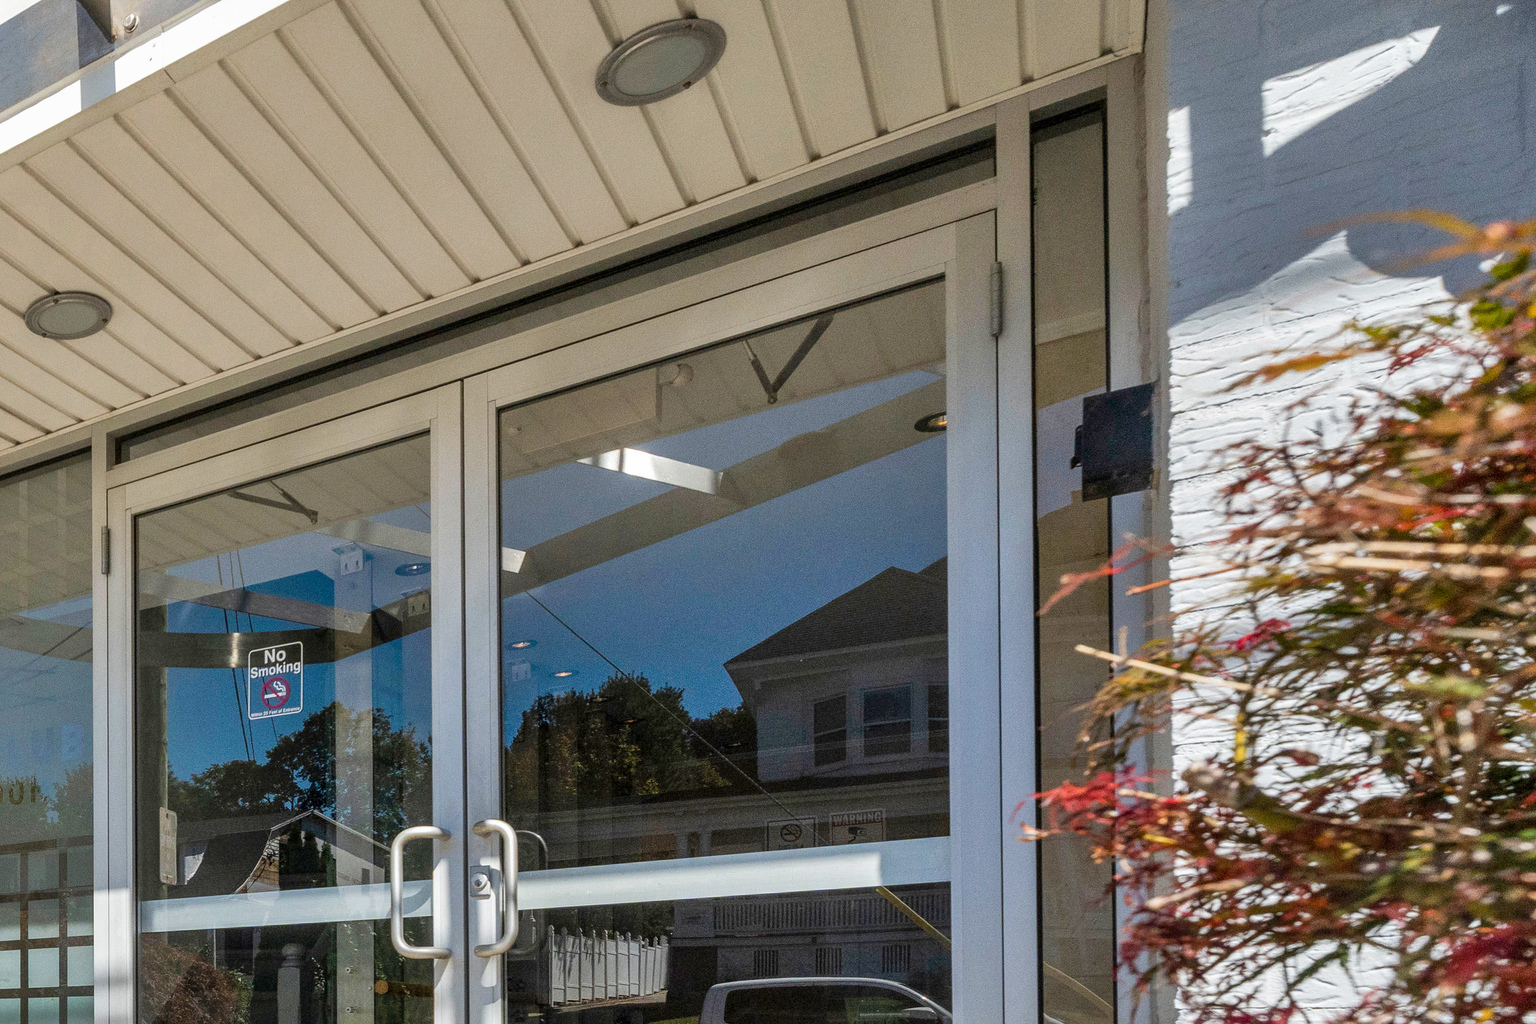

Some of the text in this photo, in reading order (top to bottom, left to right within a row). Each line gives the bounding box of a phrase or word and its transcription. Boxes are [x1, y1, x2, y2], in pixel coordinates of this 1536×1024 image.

[265, 648, 286, 664] No
[250, 661, 301, 679] Smoking
[833, 811, 882, 825] WARNING
